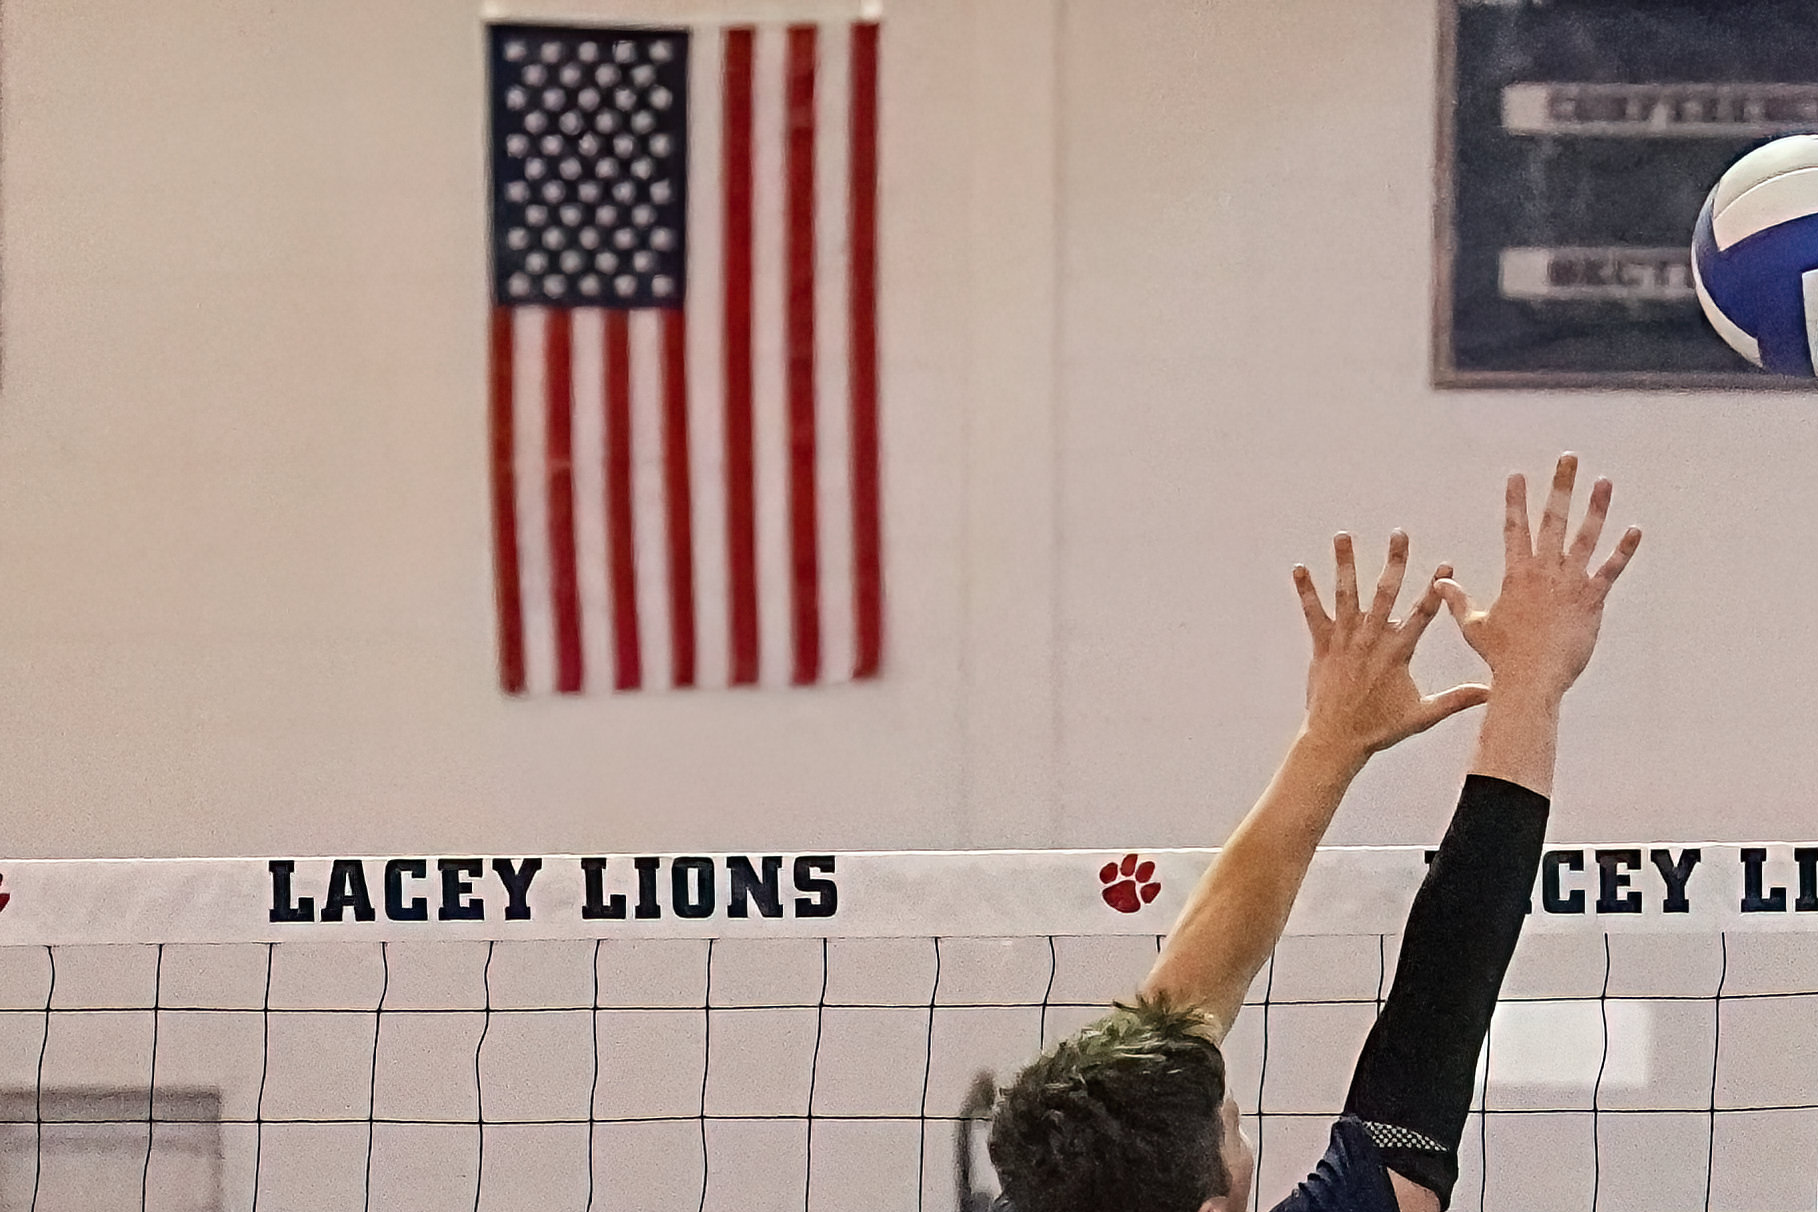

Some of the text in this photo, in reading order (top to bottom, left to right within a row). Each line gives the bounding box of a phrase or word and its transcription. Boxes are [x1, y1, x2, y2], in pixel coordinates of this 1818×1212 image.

[268, 854, 838, 923] LACEY LIONS
[1425, 847, 1701, 915] CEY
